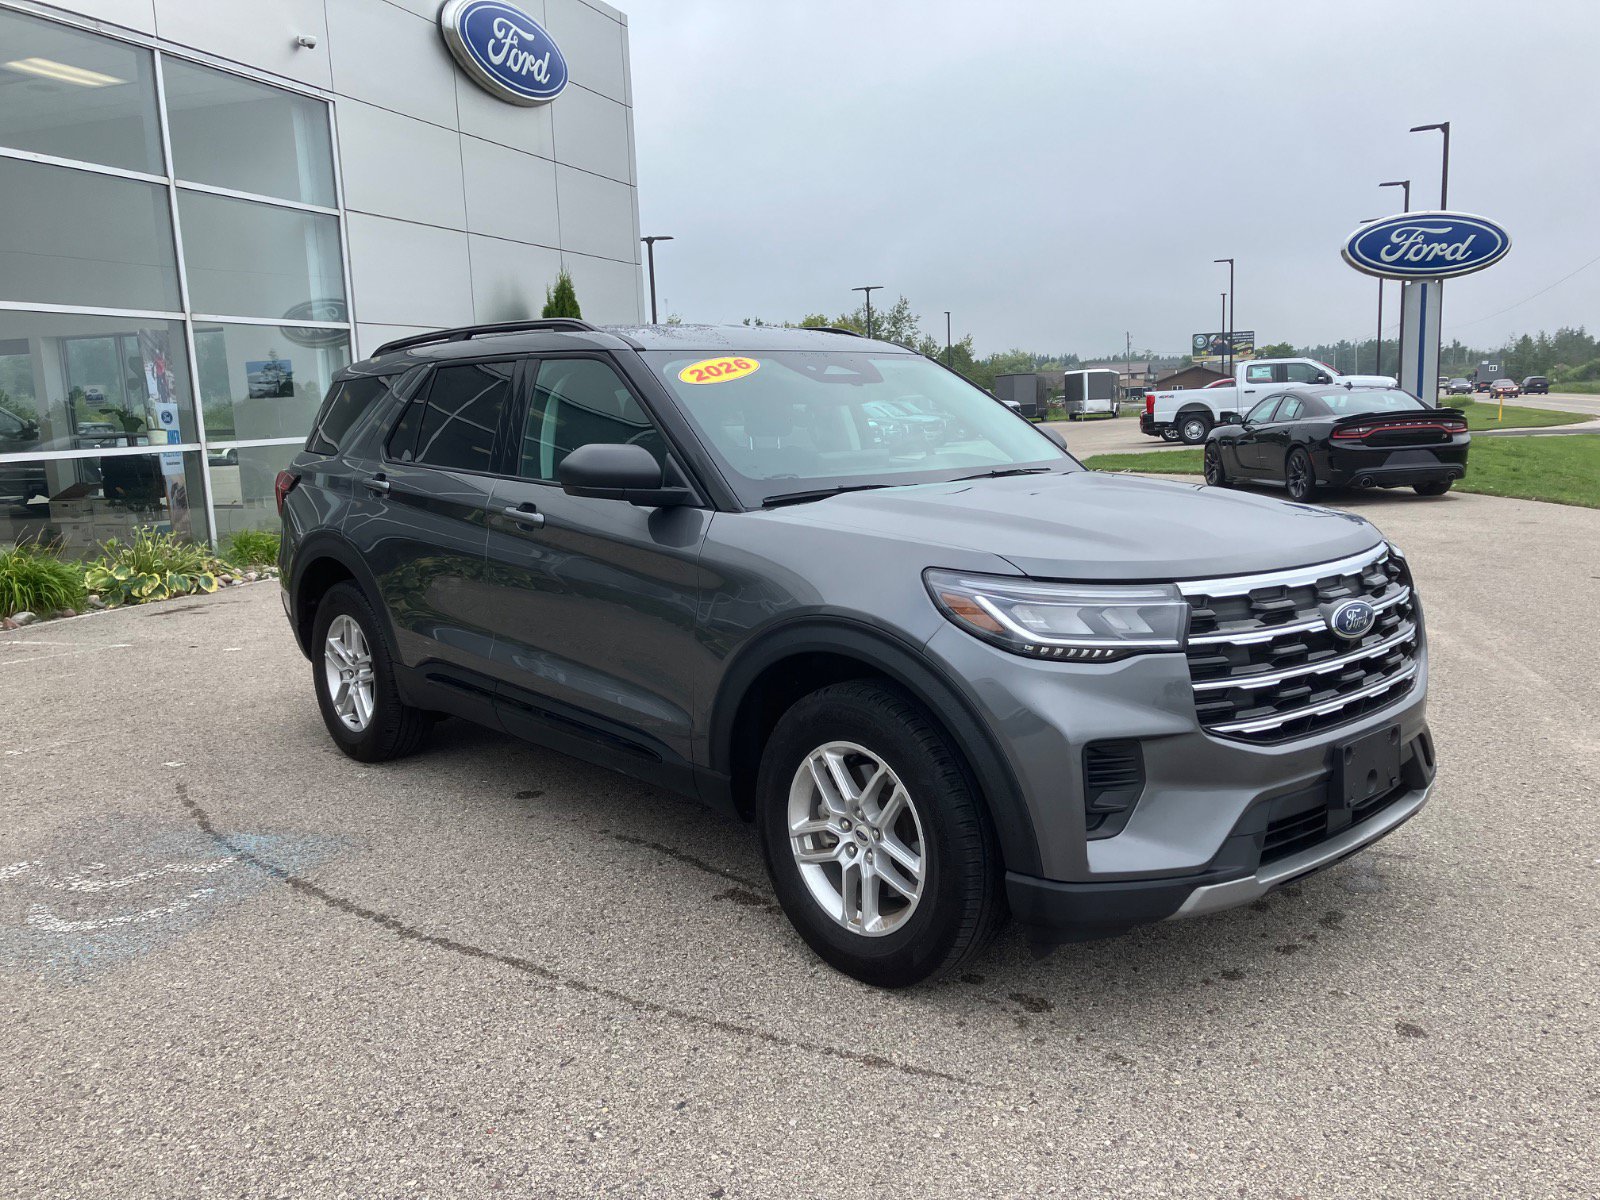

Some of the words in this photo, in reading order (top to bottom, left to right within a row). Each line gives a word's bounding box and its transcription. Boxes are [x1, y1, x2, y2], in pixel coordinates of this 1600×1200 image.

[487, 17, 551, 84] Ford
[1380, 226, 1477, 262] Ford
[689, 359, 751, 382] 2026
[1346, 608, 1369, 630] Ford
